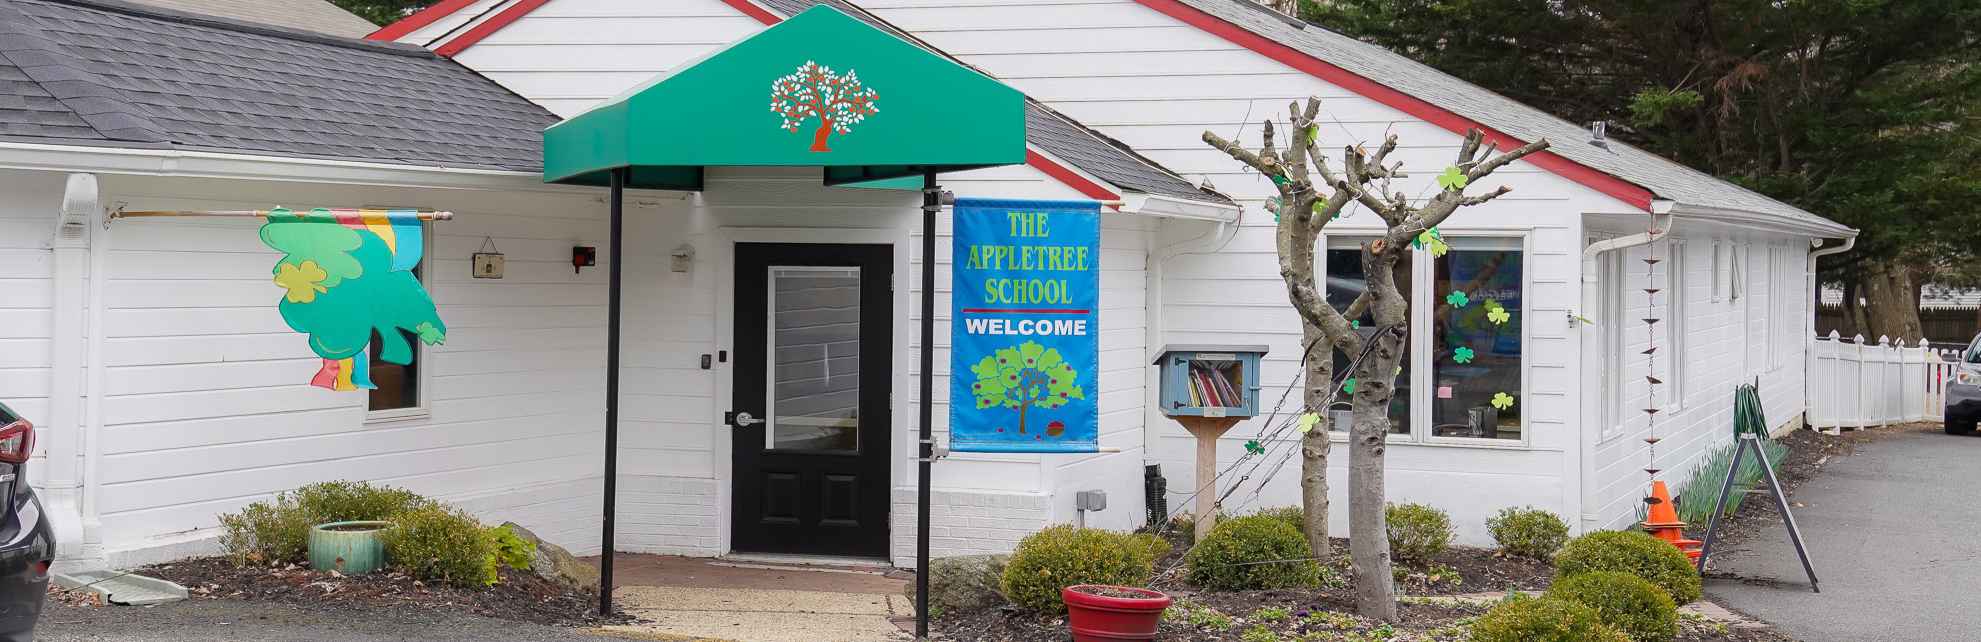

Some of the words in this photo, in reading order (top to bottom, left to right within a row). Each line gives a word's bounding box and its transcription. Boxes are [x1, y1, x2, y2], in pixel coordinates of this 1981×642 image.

[1008, 213, 1048, 236] THE
[968, 246, 1088, 270] APPLETREE
[986, 279, 1072, 304] SCHOOL
[966, 319, 1086, 335] WELCOME
